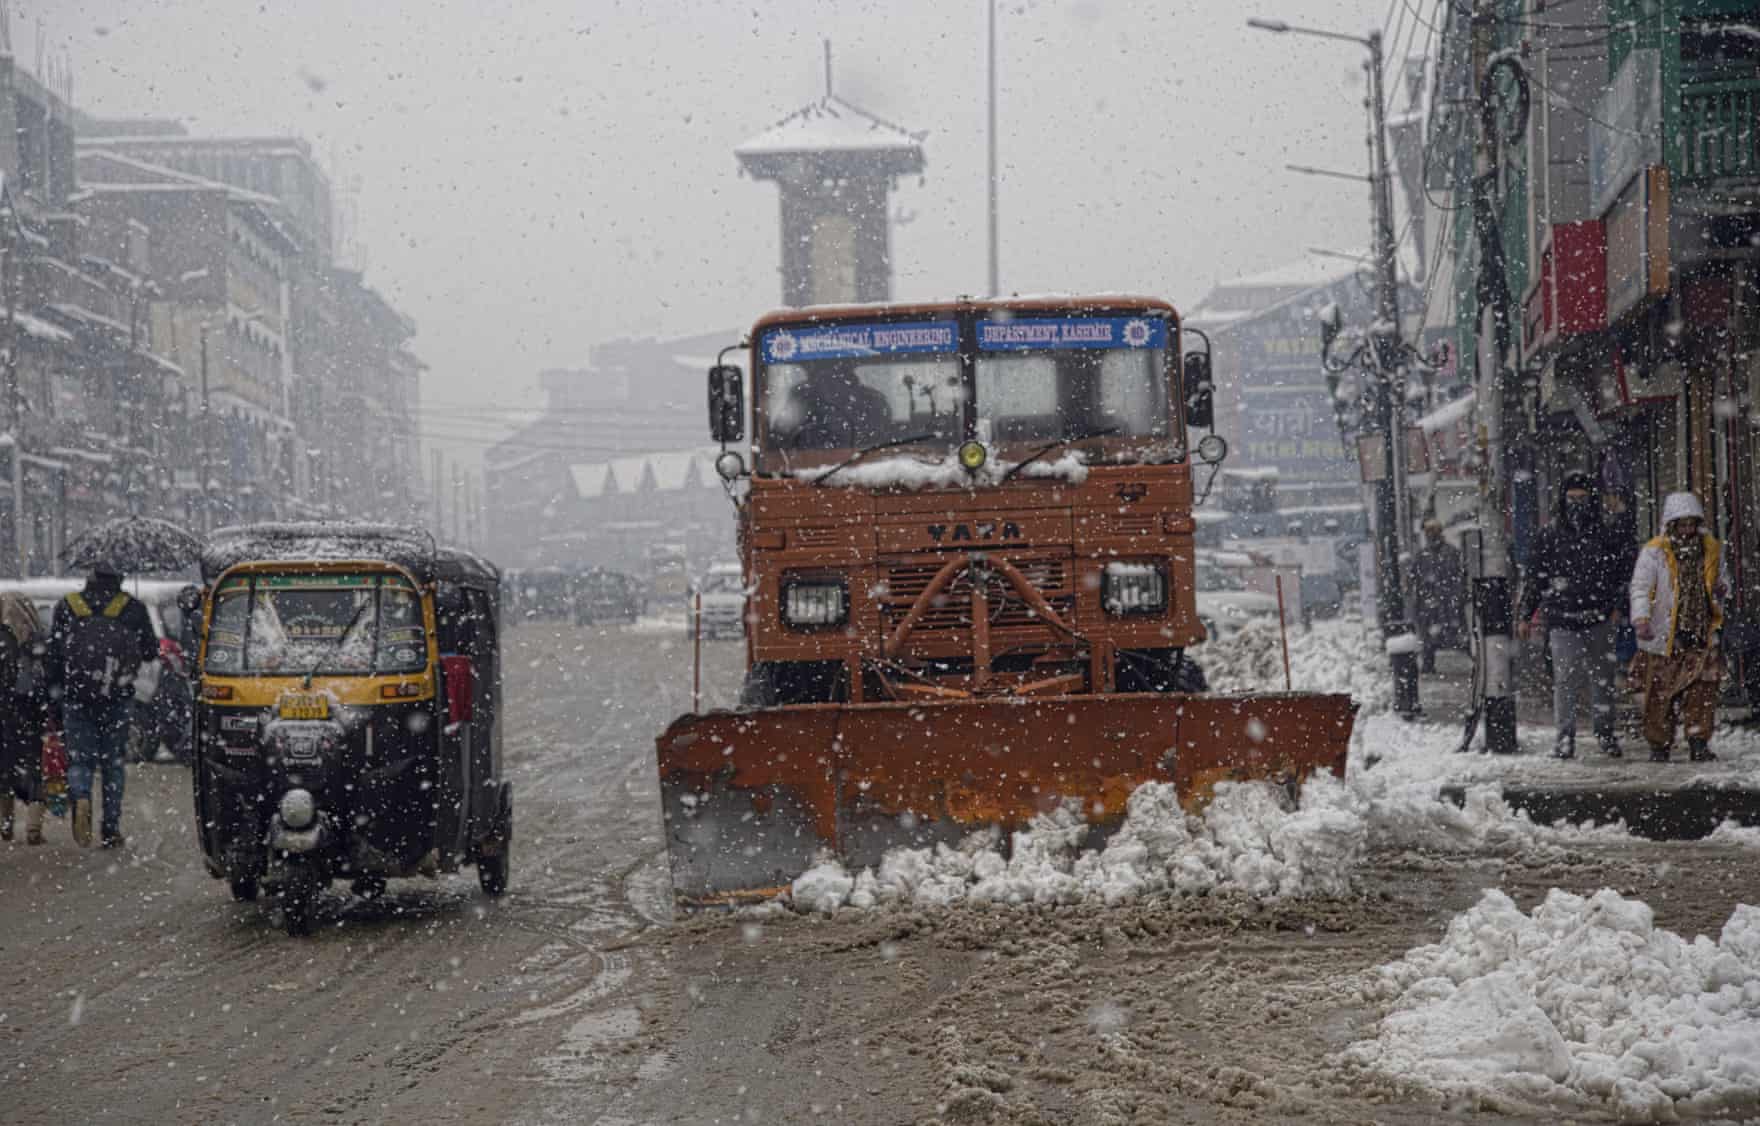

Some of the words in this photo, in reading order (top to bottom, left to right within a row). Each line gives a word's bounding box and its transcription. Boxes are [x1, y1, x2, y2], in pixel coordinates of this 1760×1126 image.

[799, 330, 870, 353] MECHANICAL
[873, 327, 952, 347] ENGINEERING
[1061, 323, 1113, 342] KASHMIR
